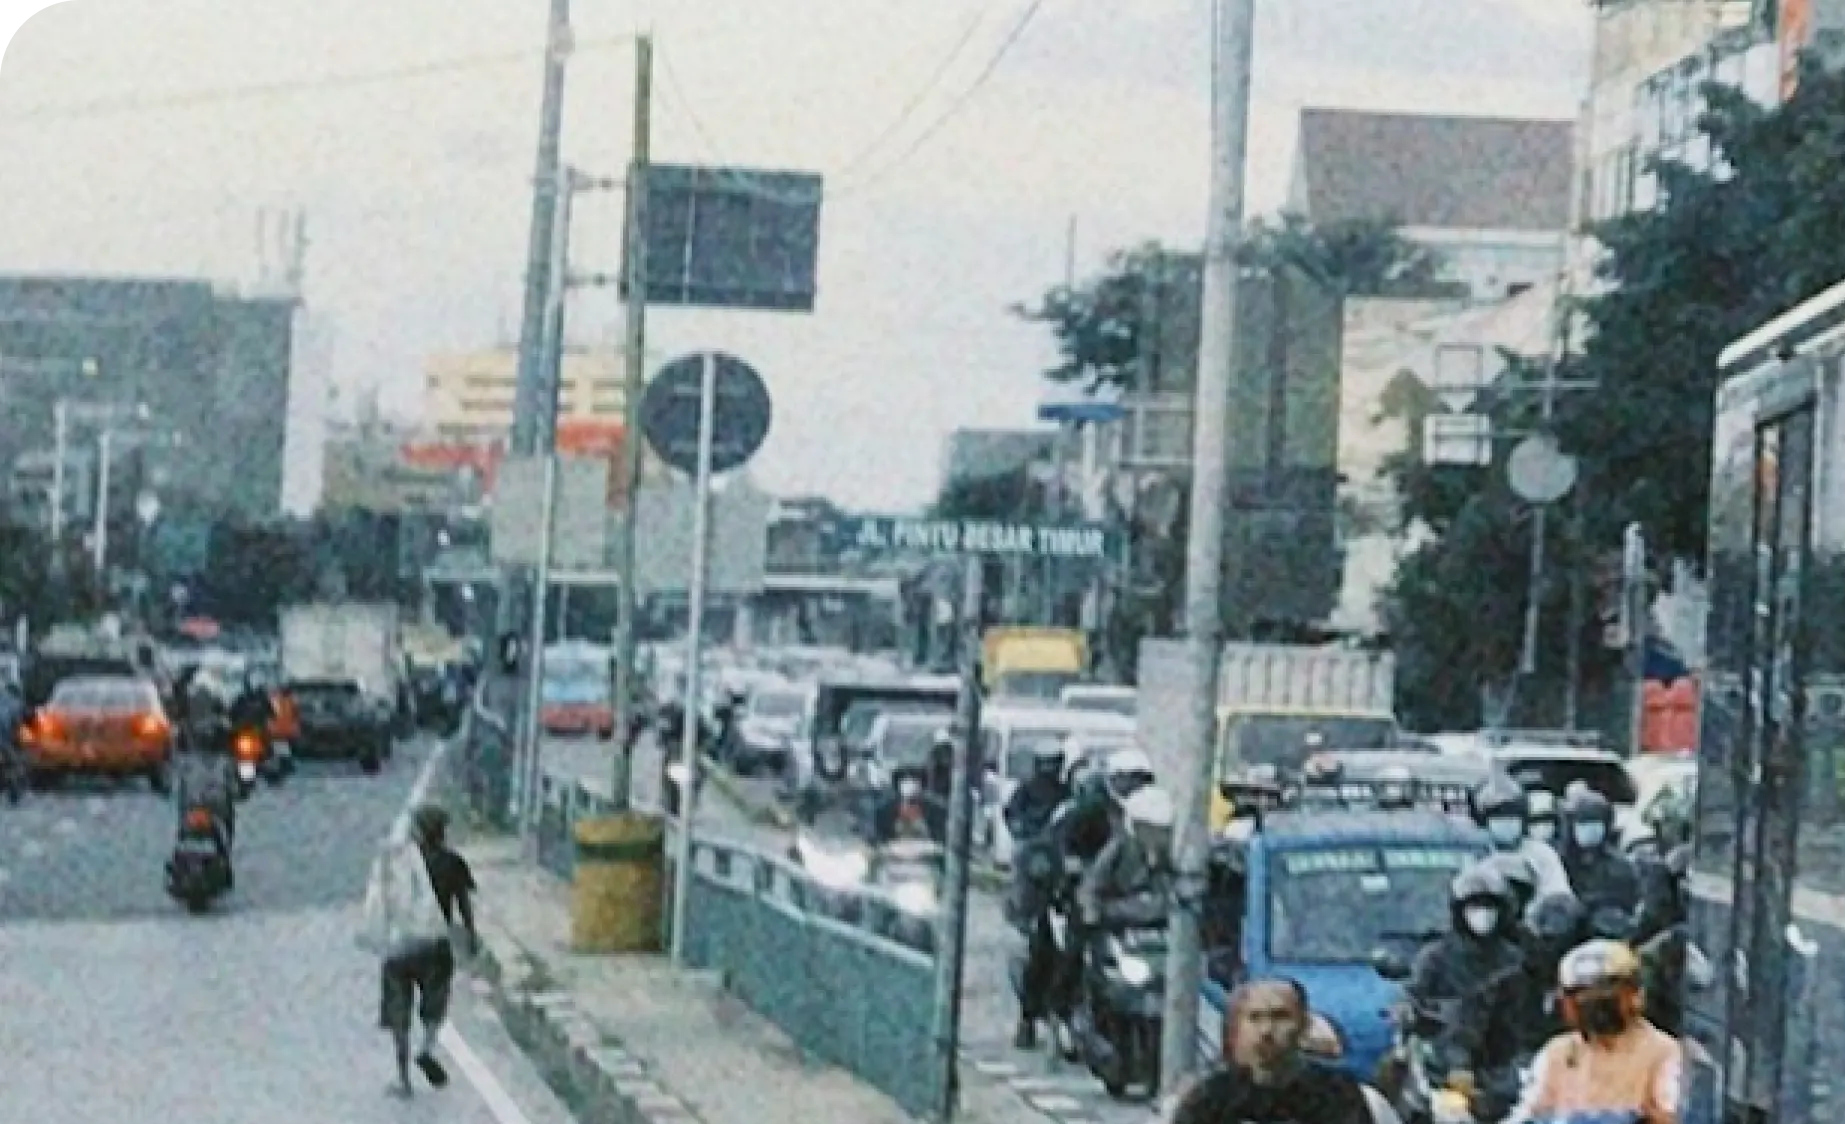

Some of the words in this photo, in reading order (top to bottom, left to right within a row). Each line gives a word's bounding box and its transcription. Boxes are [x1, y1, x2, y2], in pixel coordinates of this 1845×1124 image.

[893, 519, 959, 550] PINTU
[962, 521, 1033, 553] BESAR
[1038, 526, 1106, 556] TIMUR
